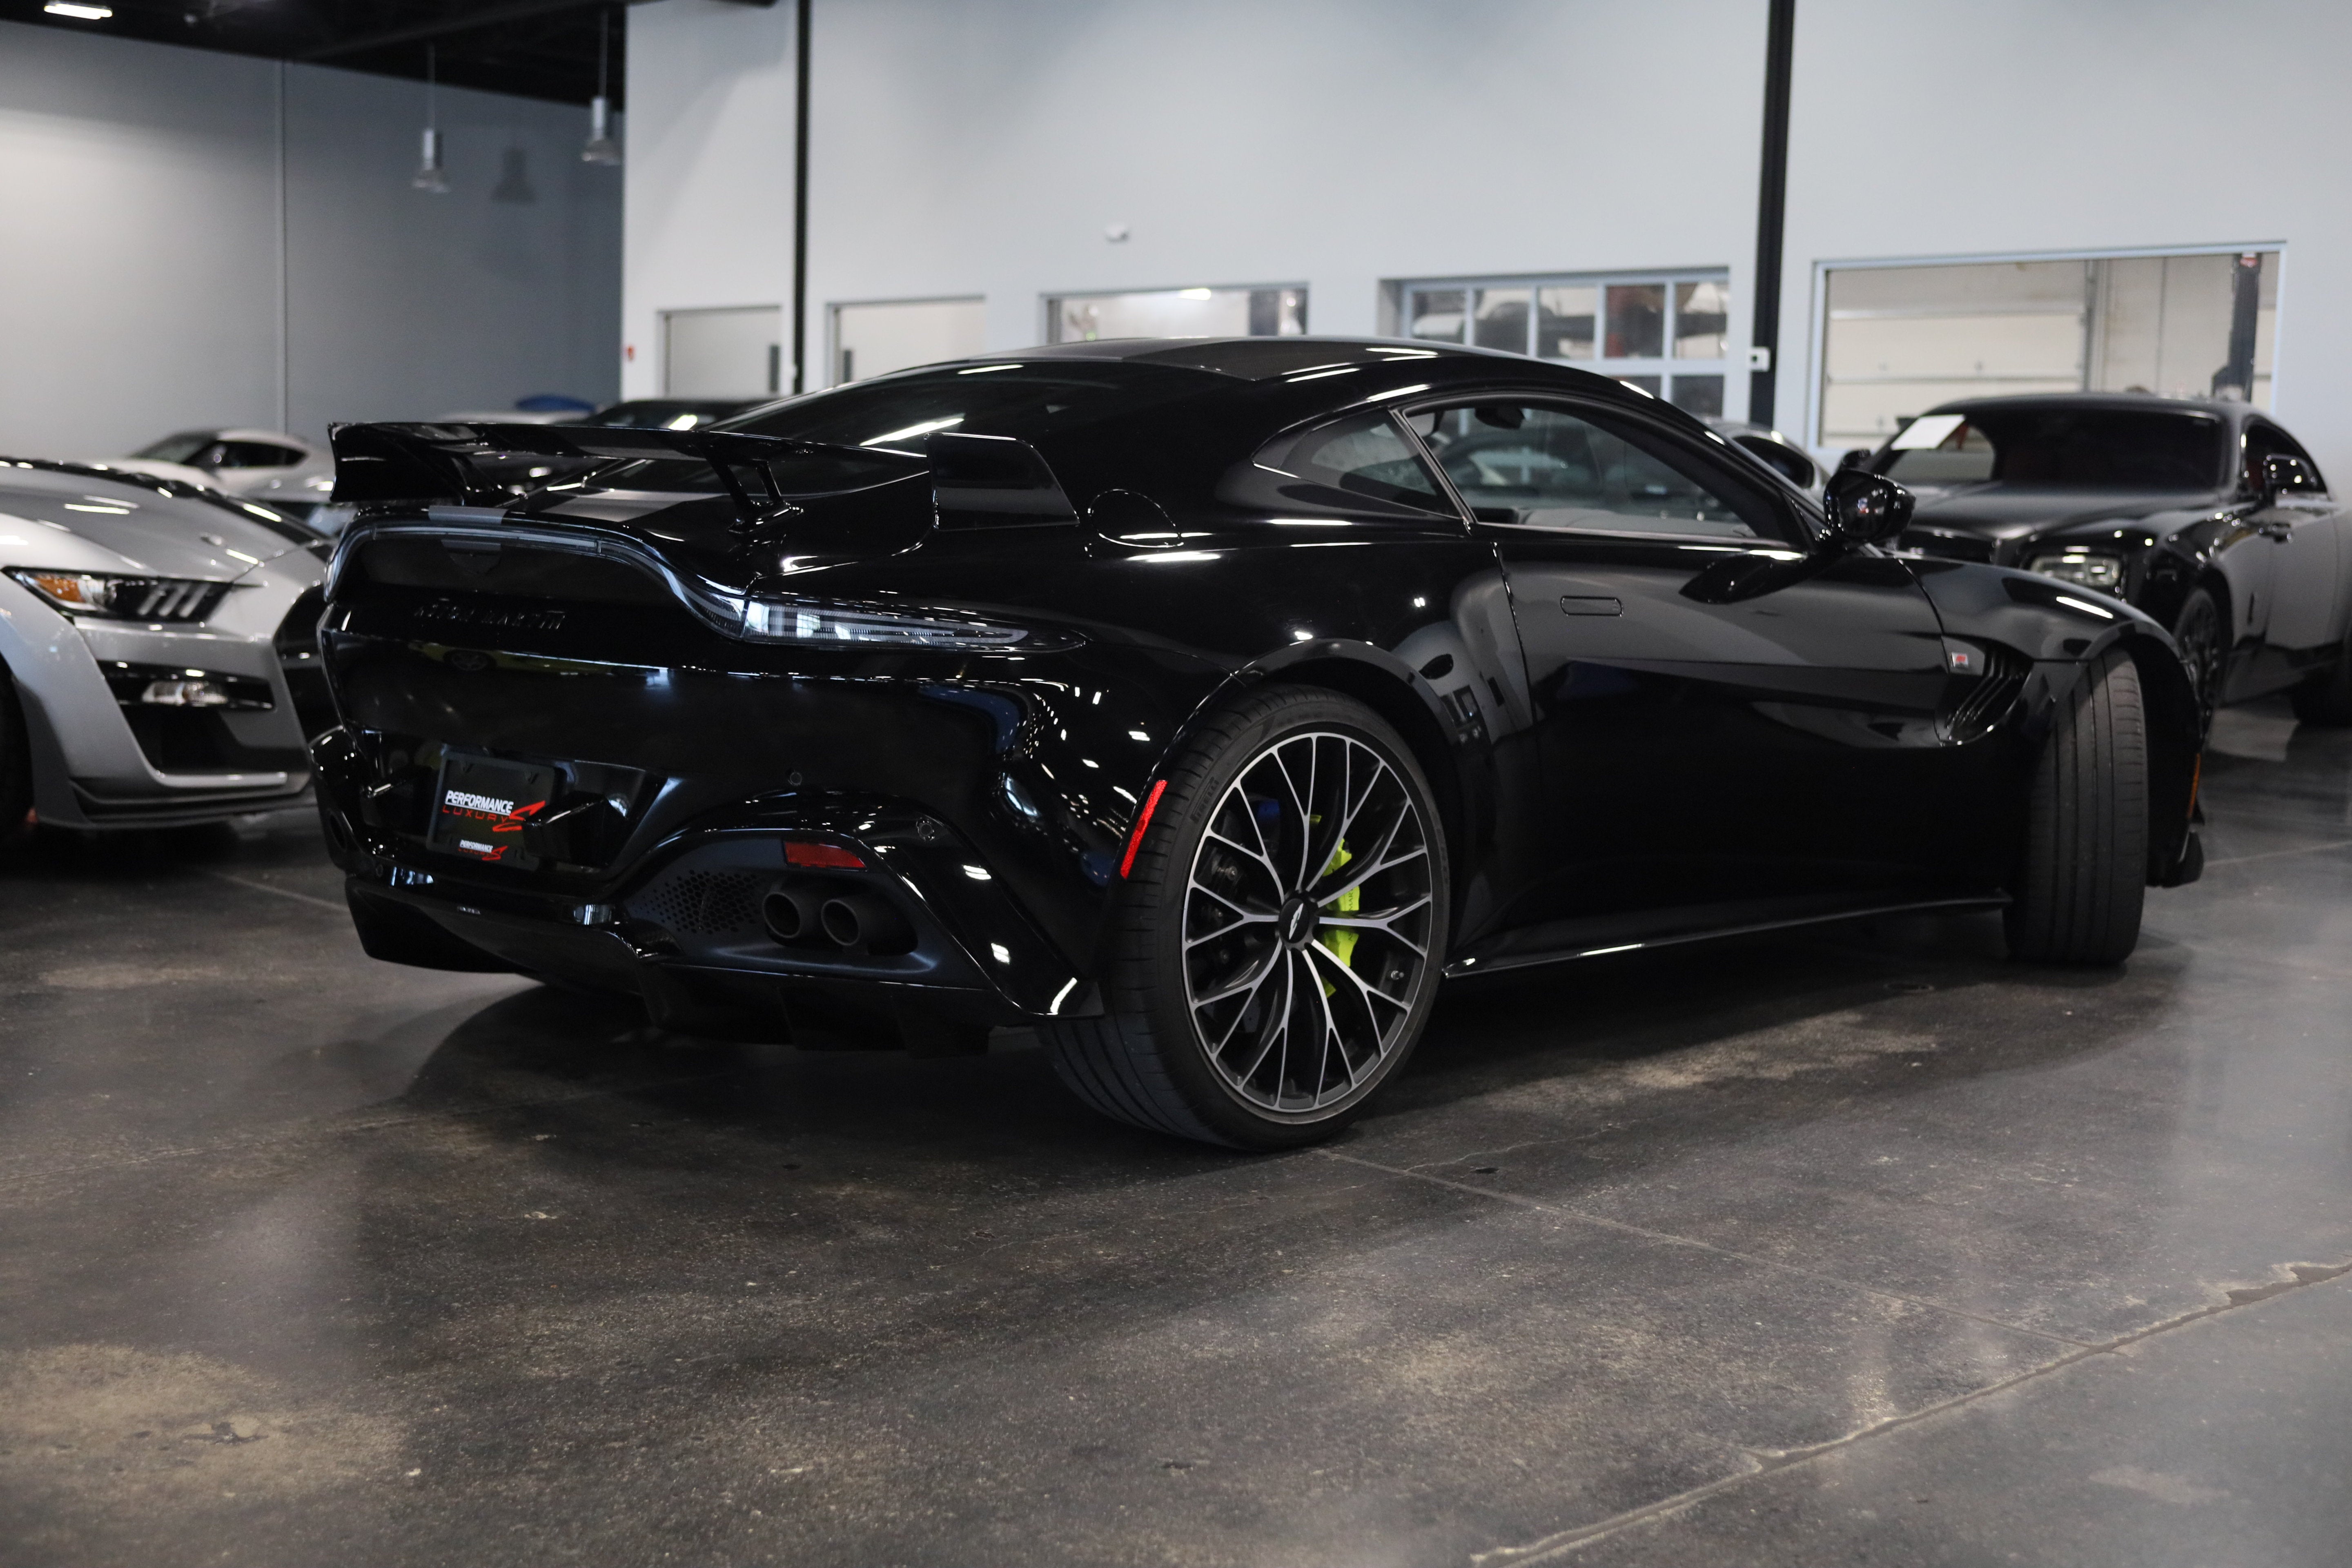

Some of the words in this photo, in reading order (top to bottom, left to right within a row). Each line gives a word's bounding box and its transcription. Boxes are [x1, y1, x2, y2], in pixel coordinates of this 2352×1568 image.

[445, 789, 514, 814] PERFORMANCE
[1189, 777, 1220, 824] PIRELLI
[442, 805, 508, 823] LUXURY
[460, 839, 494, 853] PERFORMANCE
